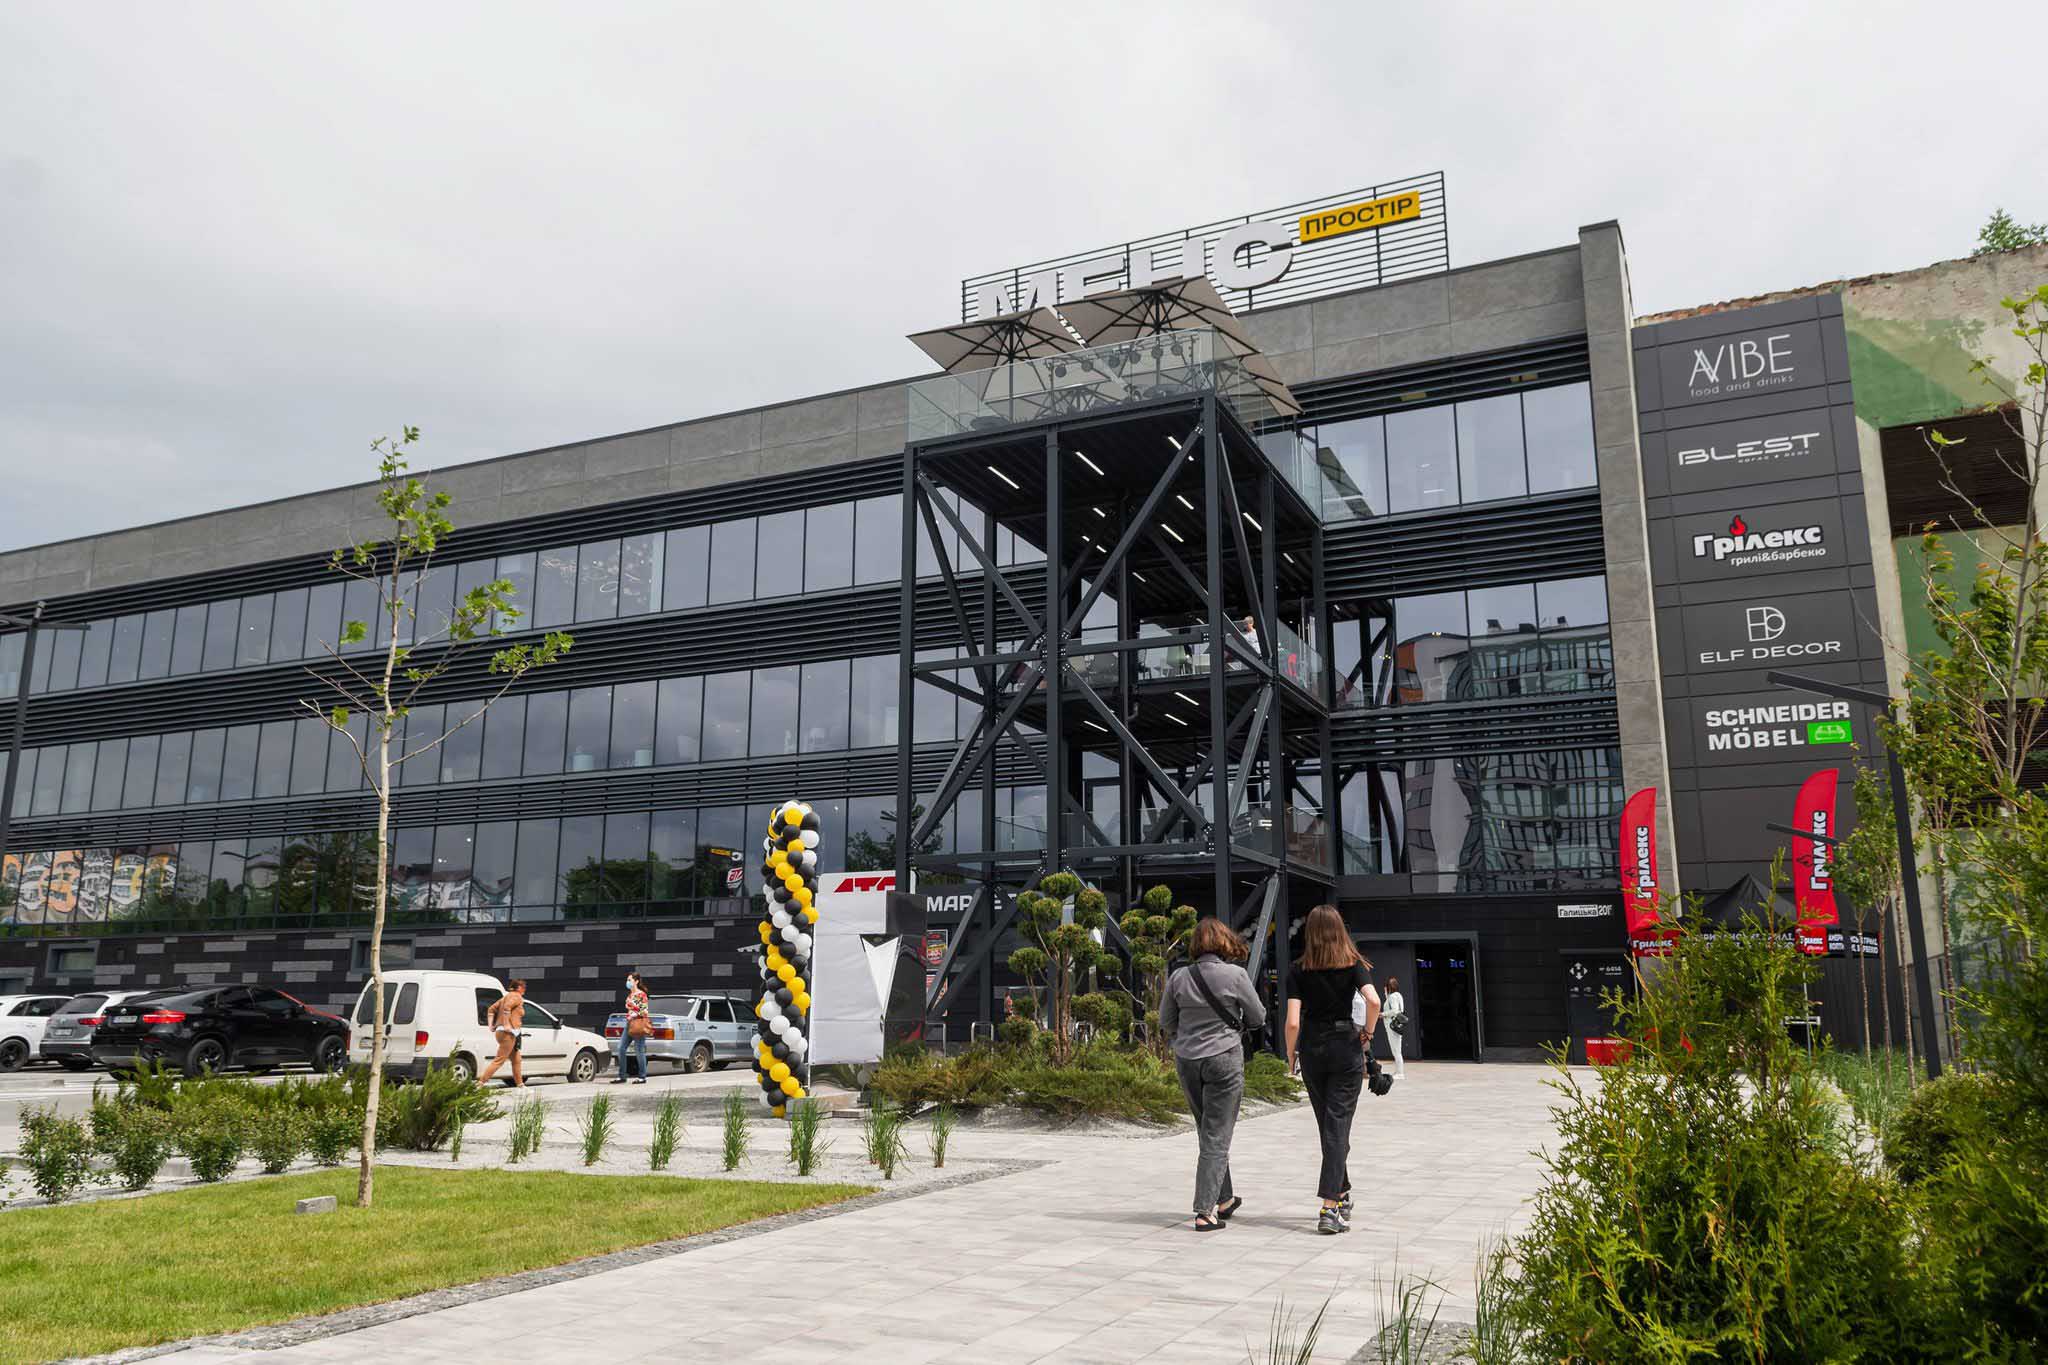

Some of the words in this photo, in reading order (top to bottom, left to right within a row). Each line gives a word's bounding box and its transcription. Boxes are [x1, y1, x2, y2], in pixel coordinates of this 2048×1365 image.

[1305, 197, 1413, 235] ПРОСТІР
[1690, 385, 1720, 397] food
[1726, 381, 1750, 392] and
[1757, 375, 1794, 387] drinks
[1678, 432, 1820, 466] BLEST
[1693, 522, 1823, 561] Грілекс
[1731, 547, 1826, 566] грилі&барбекю
[1700, 649, 1745, 664] ELF
[1752, 641, 1841, 659] DECOR
[1705, 701, 1850, 727] SCHNEIDER
[1708, 727, 1804, 750] MÖBEL
[1811, 811, 1829, 890] Грілкс
